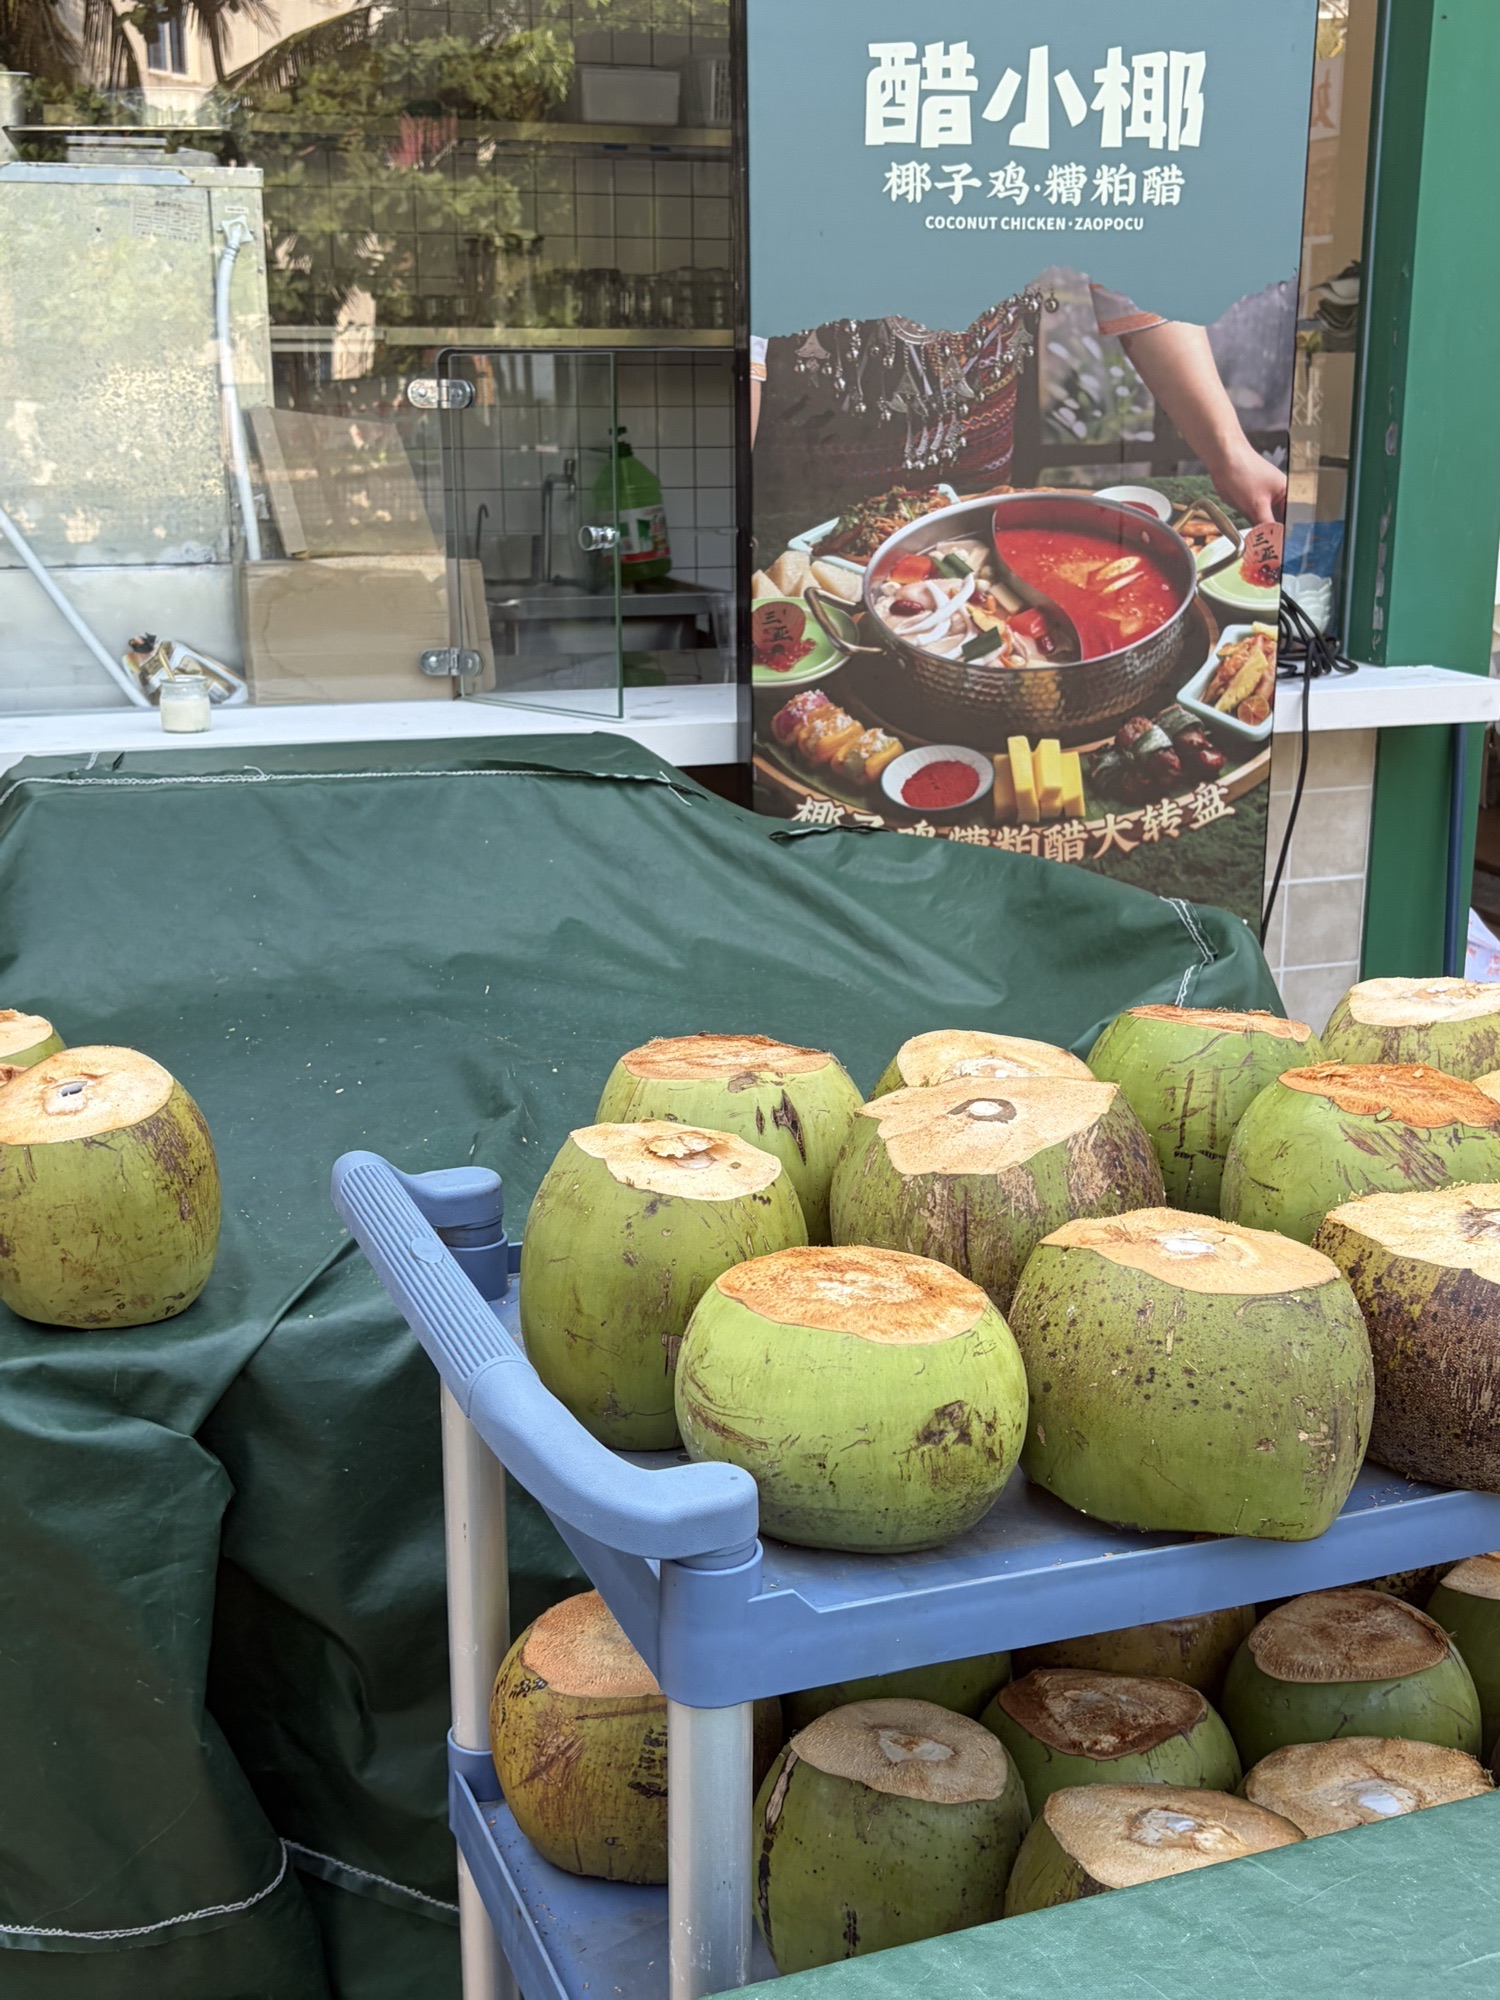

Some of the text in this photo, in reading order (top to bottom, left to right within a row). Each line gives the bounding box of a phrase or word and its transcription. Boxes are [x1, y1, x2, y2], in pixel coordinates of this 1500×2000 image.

[865, 42, 1205, 151] 醋小椰
[882, 160, 1185, 206] 椰子鸡·糟粕醋
[925, 216, 998, 230] COCONUT
